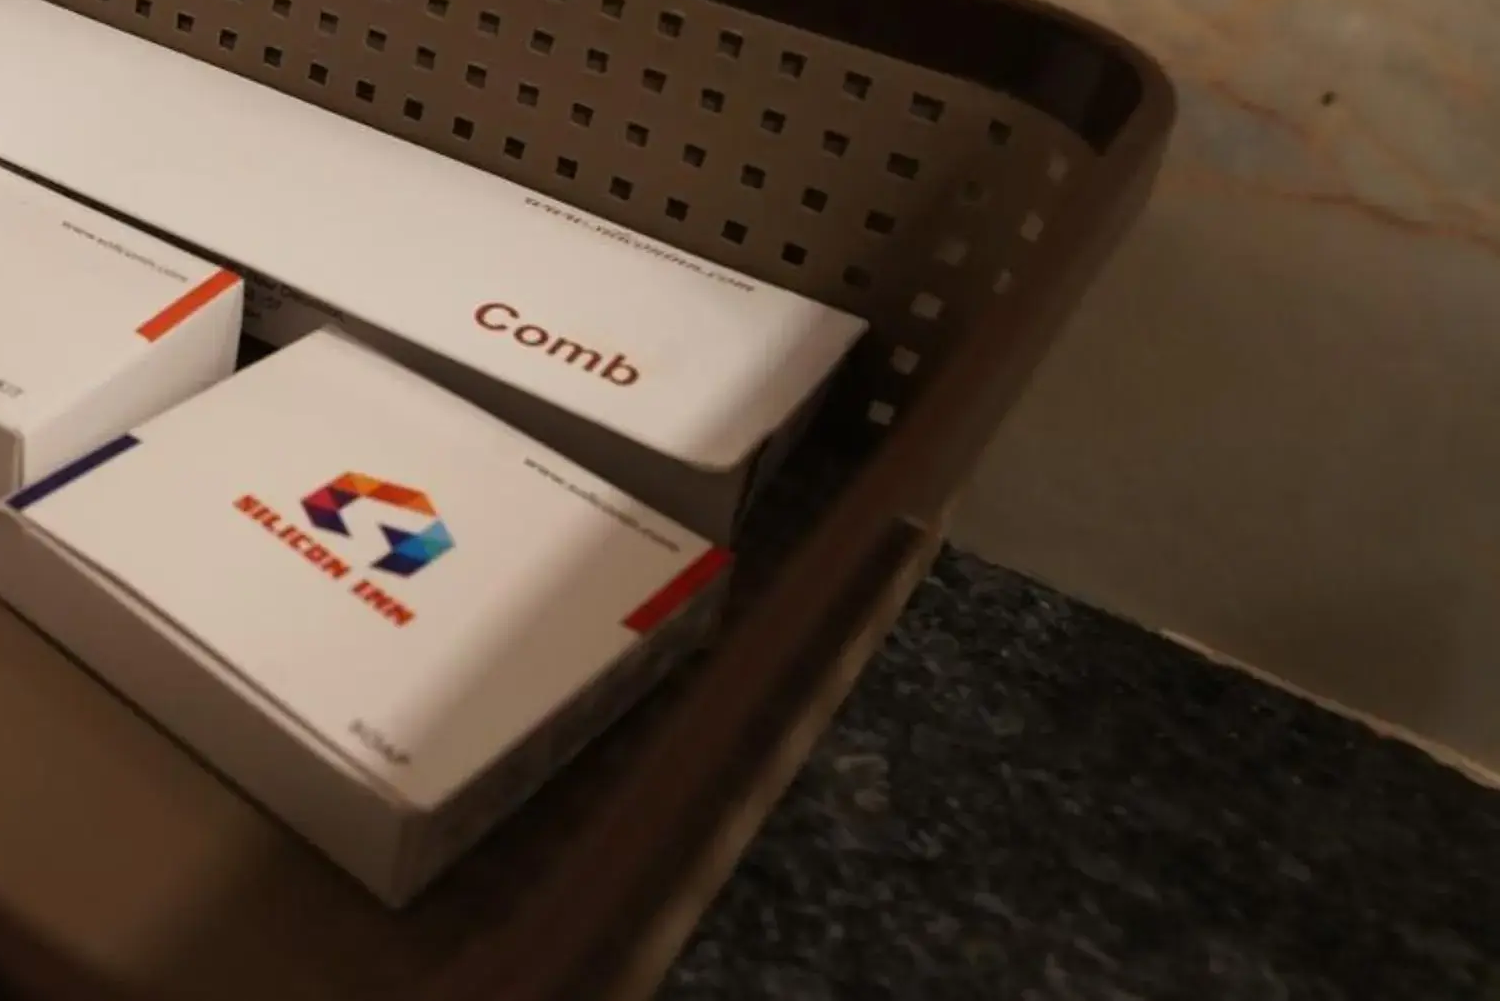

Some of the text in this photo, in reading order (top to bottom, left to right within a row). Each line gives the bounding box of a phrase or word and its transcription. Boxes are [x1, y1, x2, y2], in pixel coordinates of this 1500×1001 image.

[475, 302, 640, 387] Comb
[232, 493, 417, 629] SILICON INN
